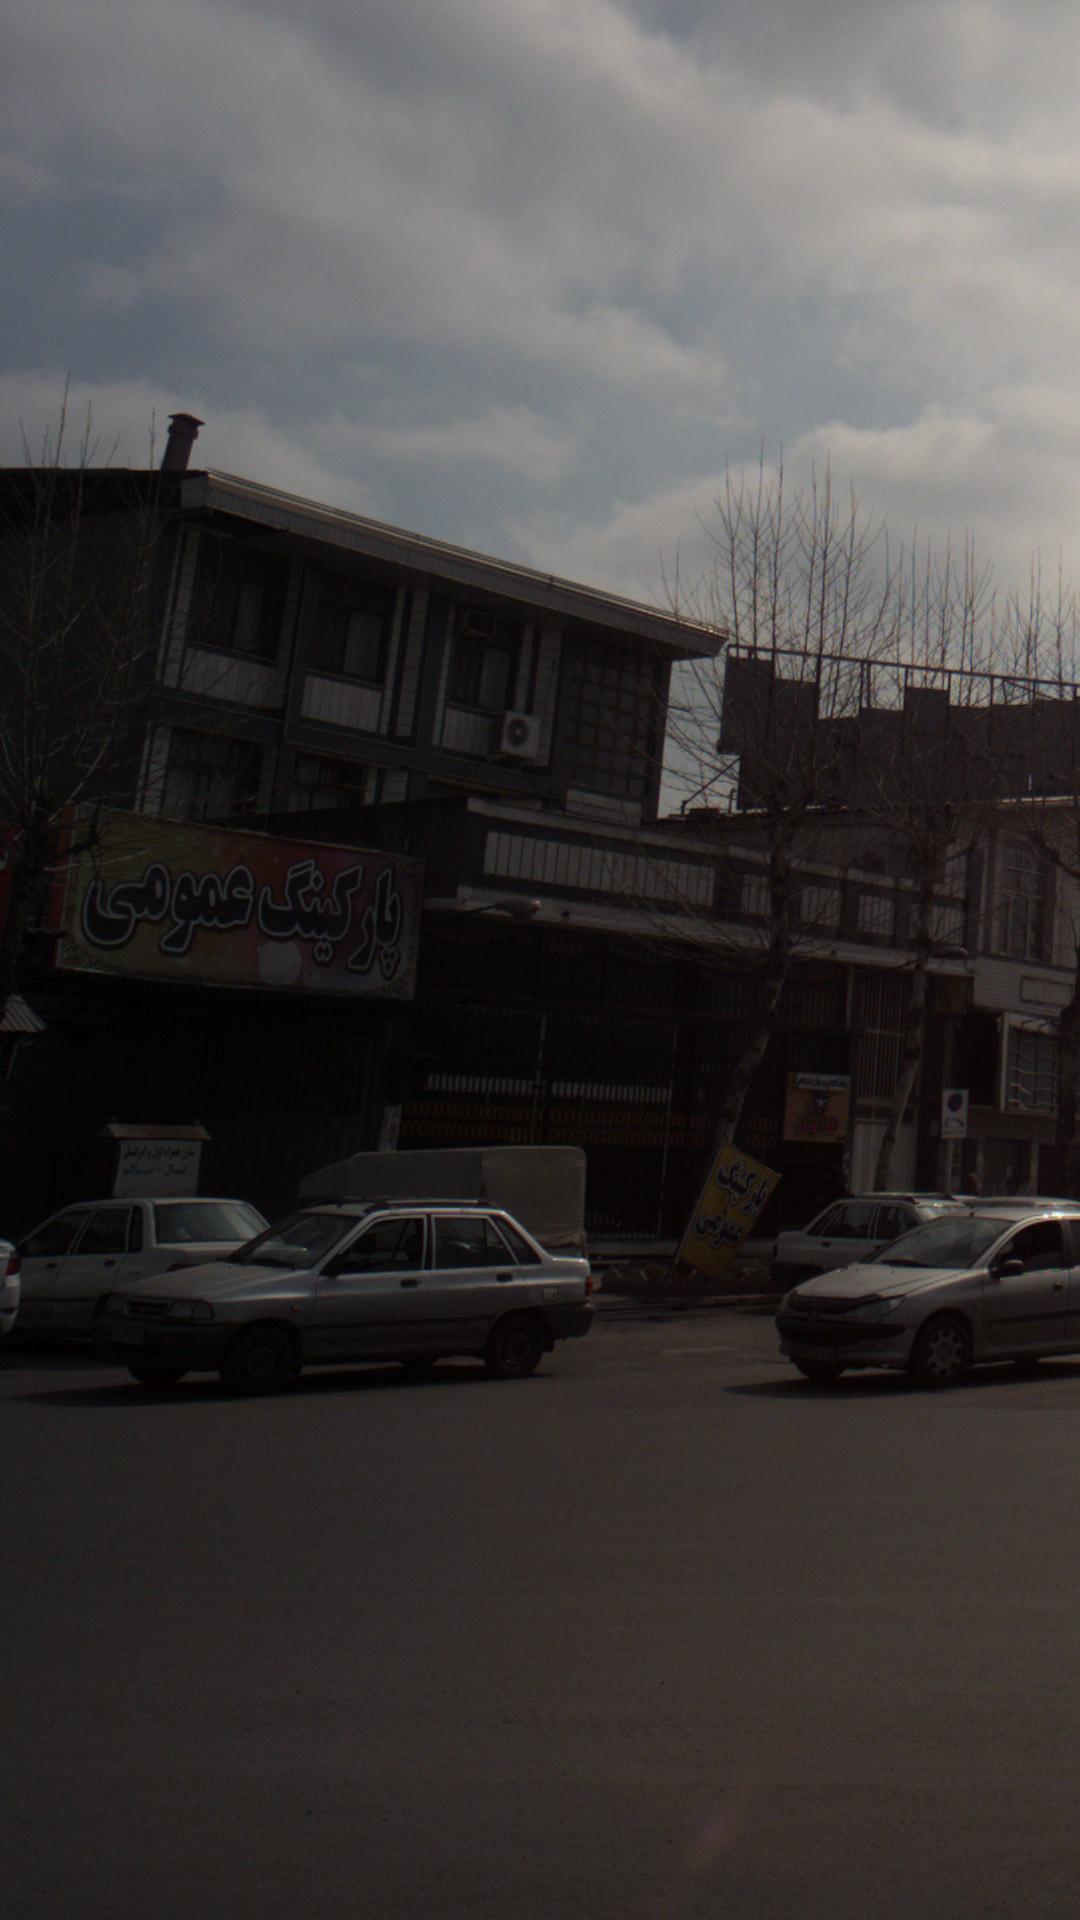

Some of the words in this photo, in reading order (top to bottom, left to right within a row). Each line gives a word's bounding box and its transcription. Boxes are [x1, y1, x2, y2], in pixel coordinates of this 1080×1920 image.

[81, 862, 256, 954] عمومی
[257, 858, 402, 980] پارکینگ
[717, 1159, 770, 1216] پارکینگ
[692, 1215, 746, 1248] عمومی
